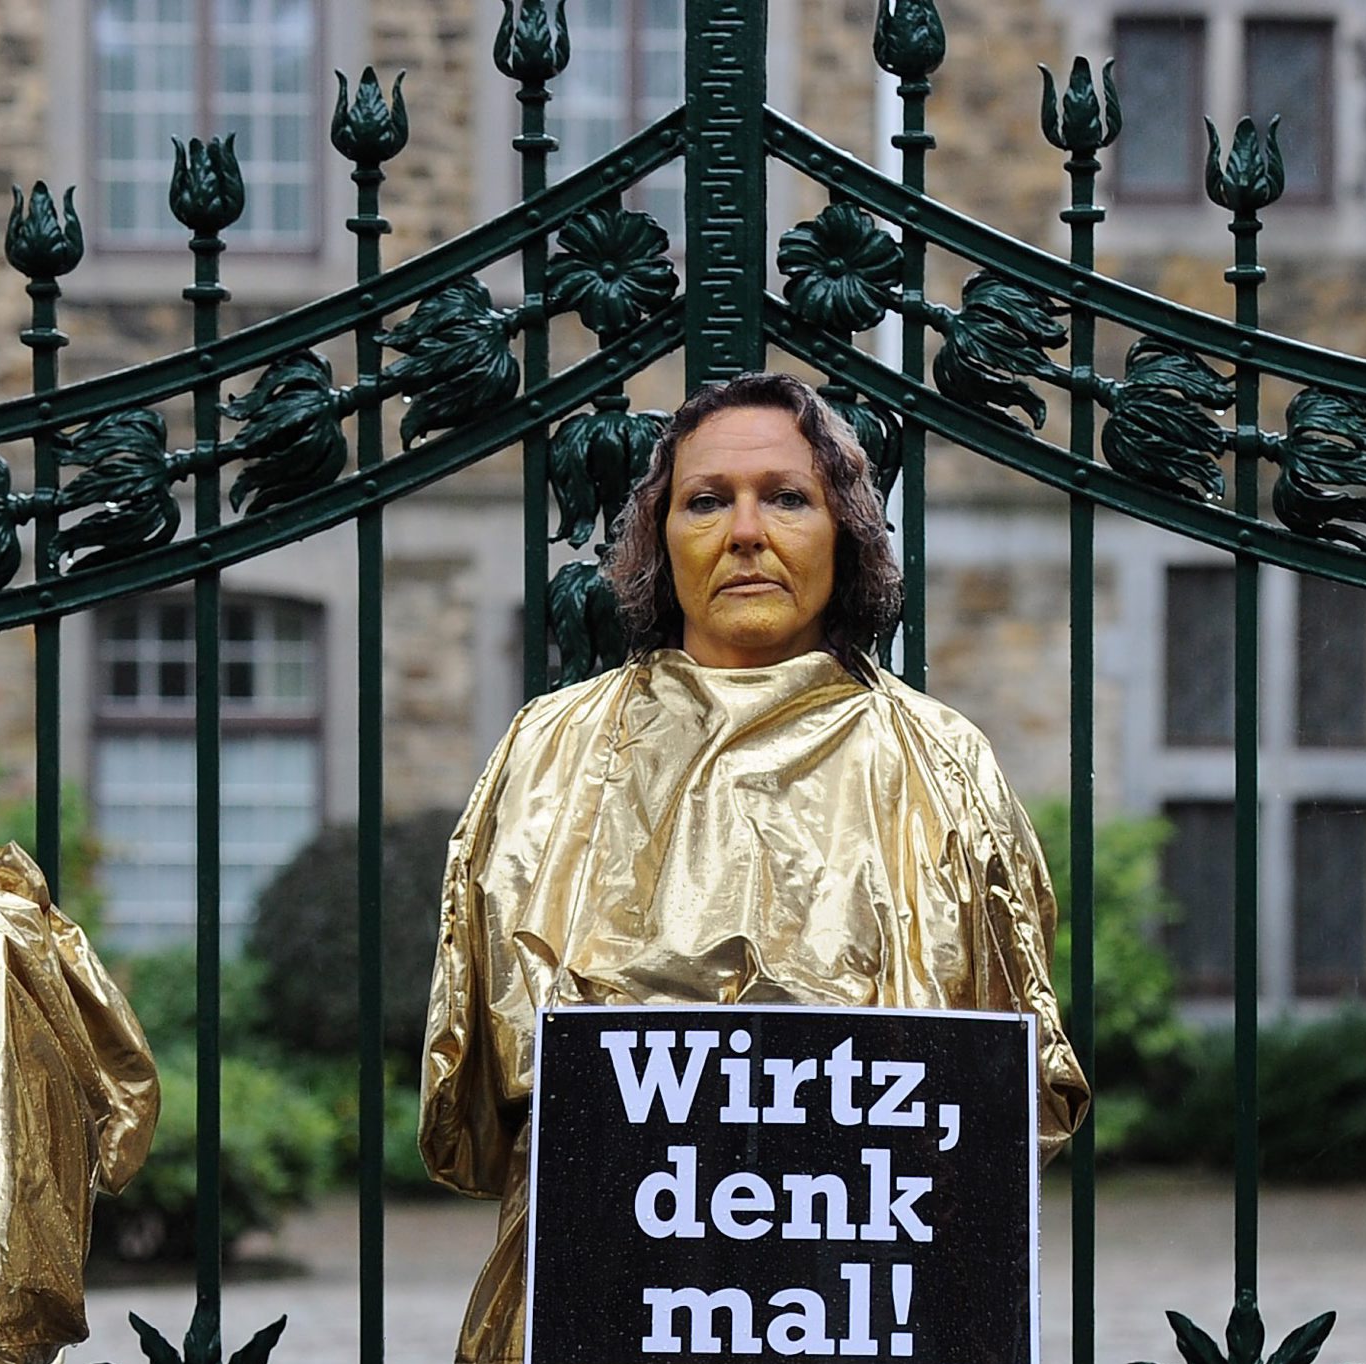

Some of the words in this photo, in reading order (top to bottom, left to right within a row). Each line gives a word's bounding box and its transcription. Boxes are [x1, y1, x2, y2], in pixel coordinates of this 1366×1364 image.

[600, 1029, 961, 1151] Wirtz,
[635, 1145, 933, 1242] denk
[641, 1262, 914, 1357] mal!
